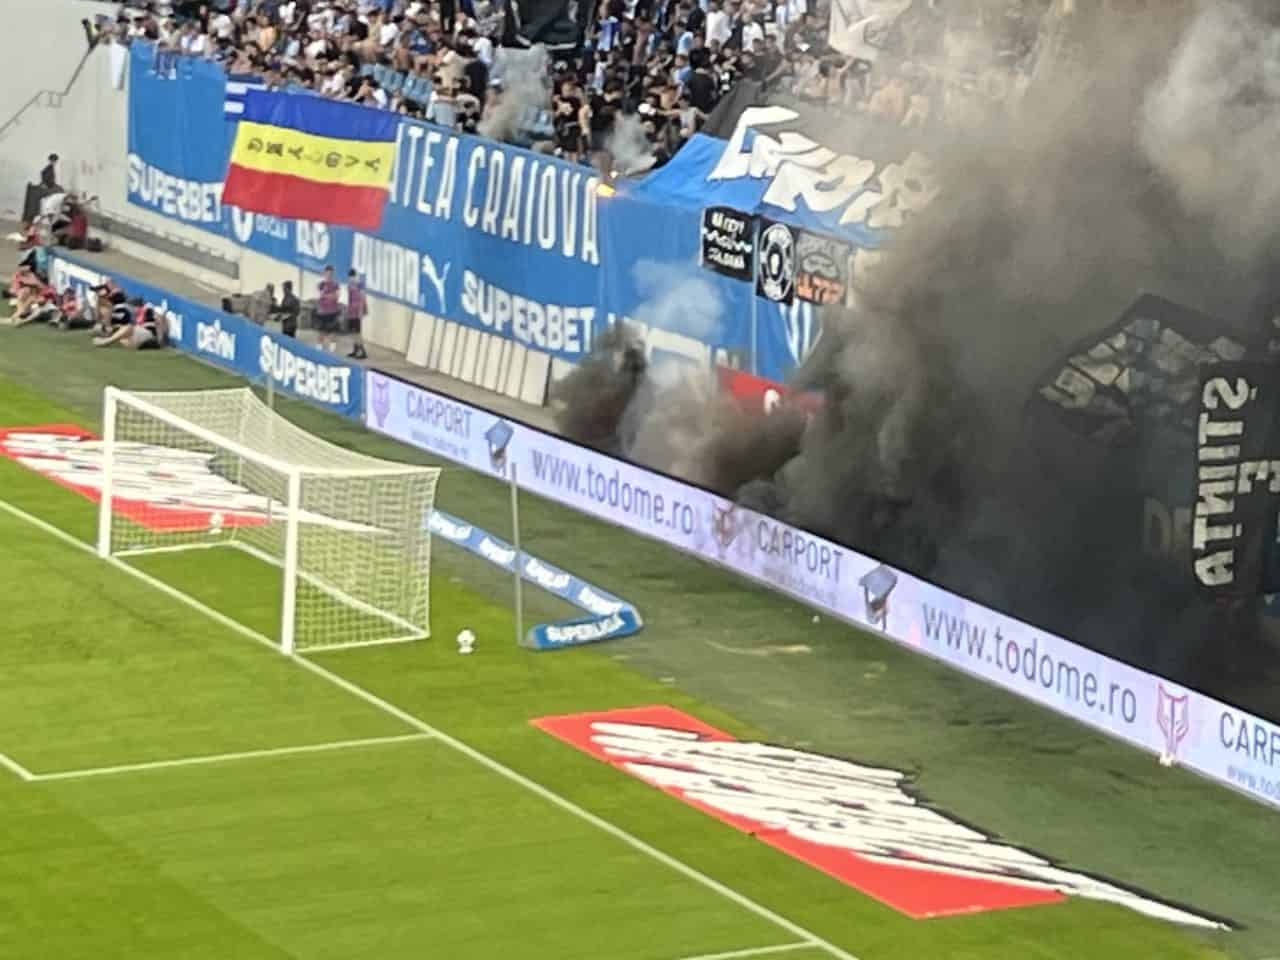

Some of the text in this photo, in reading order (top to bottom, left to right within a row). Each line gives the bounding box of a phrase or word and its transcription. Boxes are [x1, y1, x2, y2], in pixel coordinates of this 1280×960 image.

[128, 153, 222, 222] SUPERBET
[390, 122, 459, 220] TEA
[463, 145, 599, 266] CRAIOVA
[461, 269, 595, 353] SUPERBET
[259, 335, 351, 404] SUPERBET
[405, 390, 474, 440] CARPORT
[531, 448, 695, 535] www.todome.ro
[757, 520, 844, 584] CARPORT
[922, 603, 1137, 724] www.todome.ro
